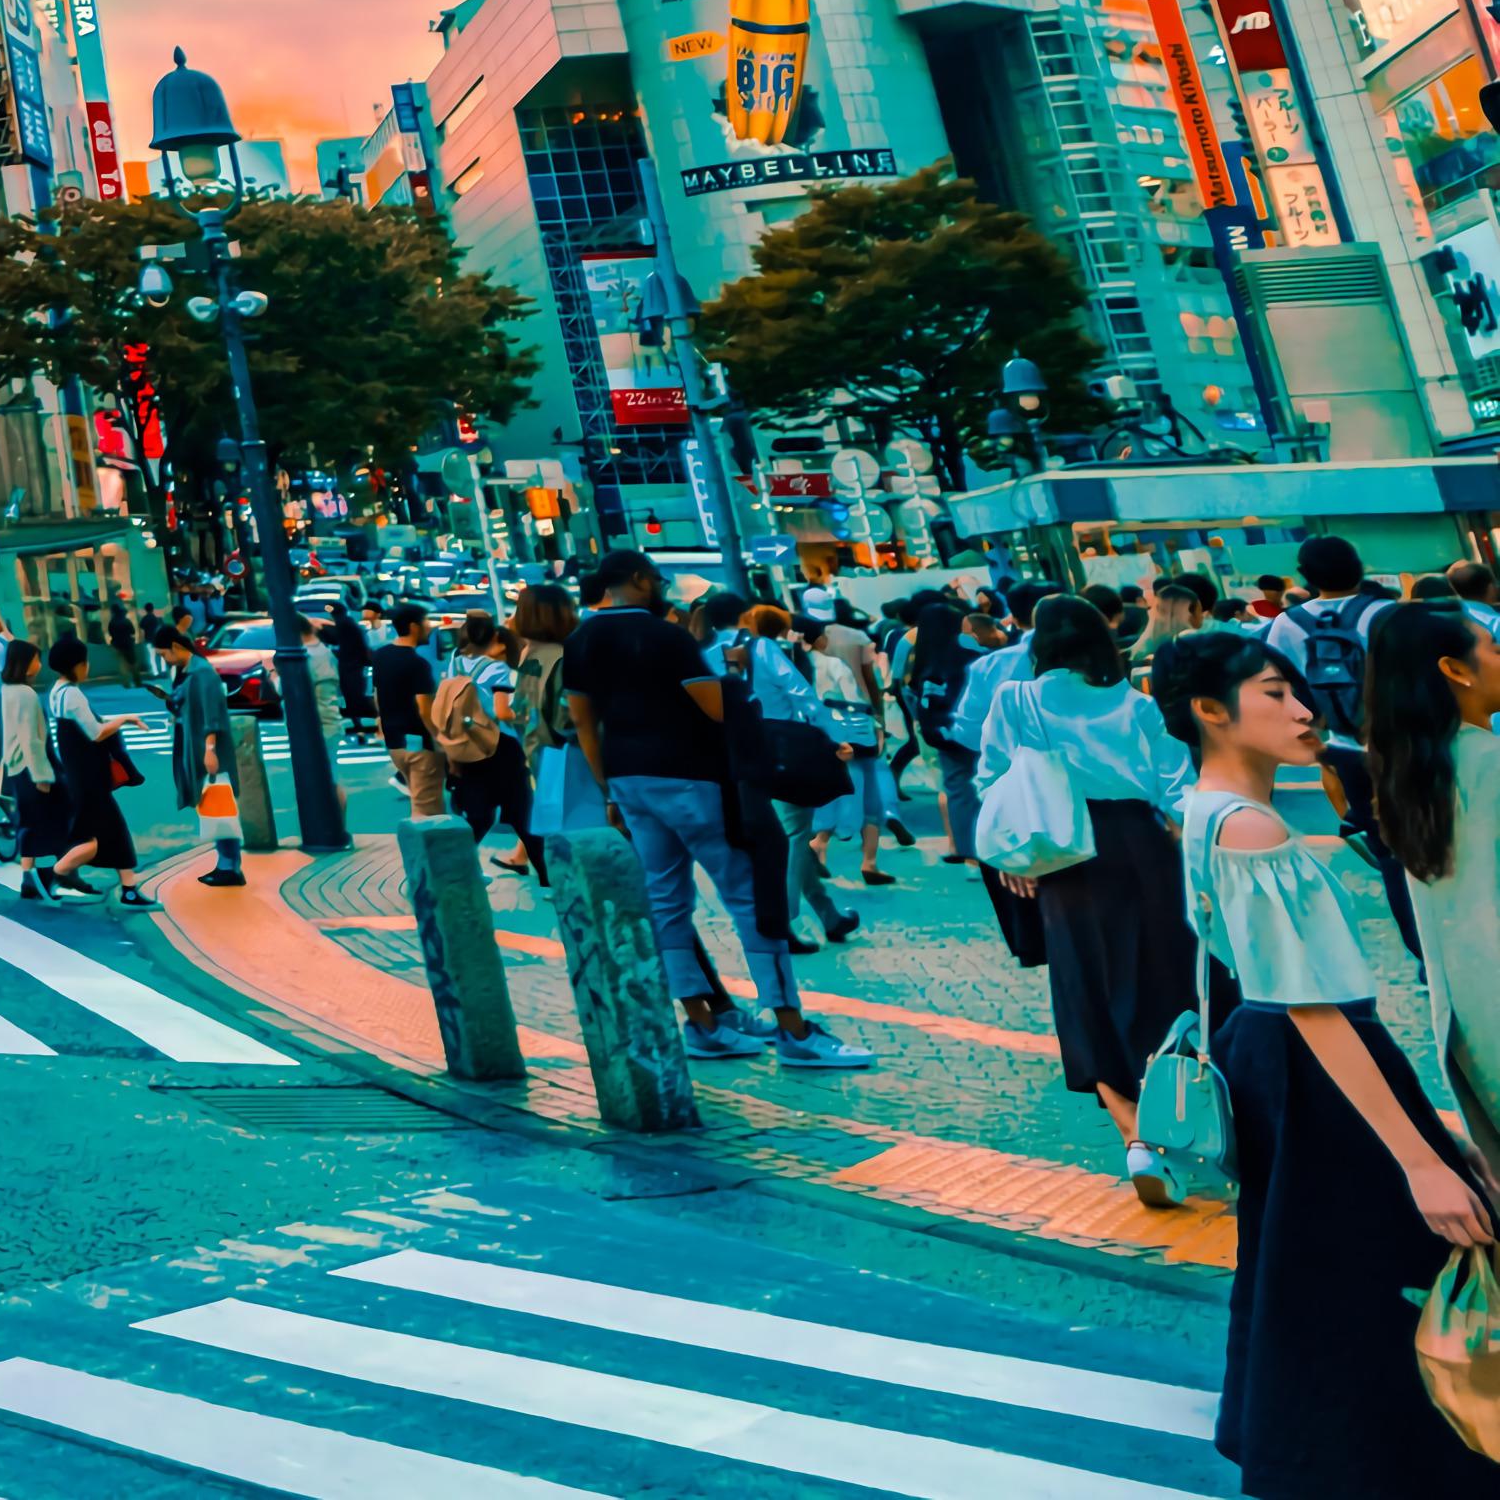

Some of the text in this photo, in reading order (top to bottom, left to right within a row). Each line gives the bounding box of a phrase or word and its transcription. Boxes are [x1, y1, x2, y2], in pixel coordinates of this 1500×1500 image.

[674, 34, 714, 55] NEW
[736, 58, 797, 99] BIG
[684, 151, 892, 189] MAYBELLINE
